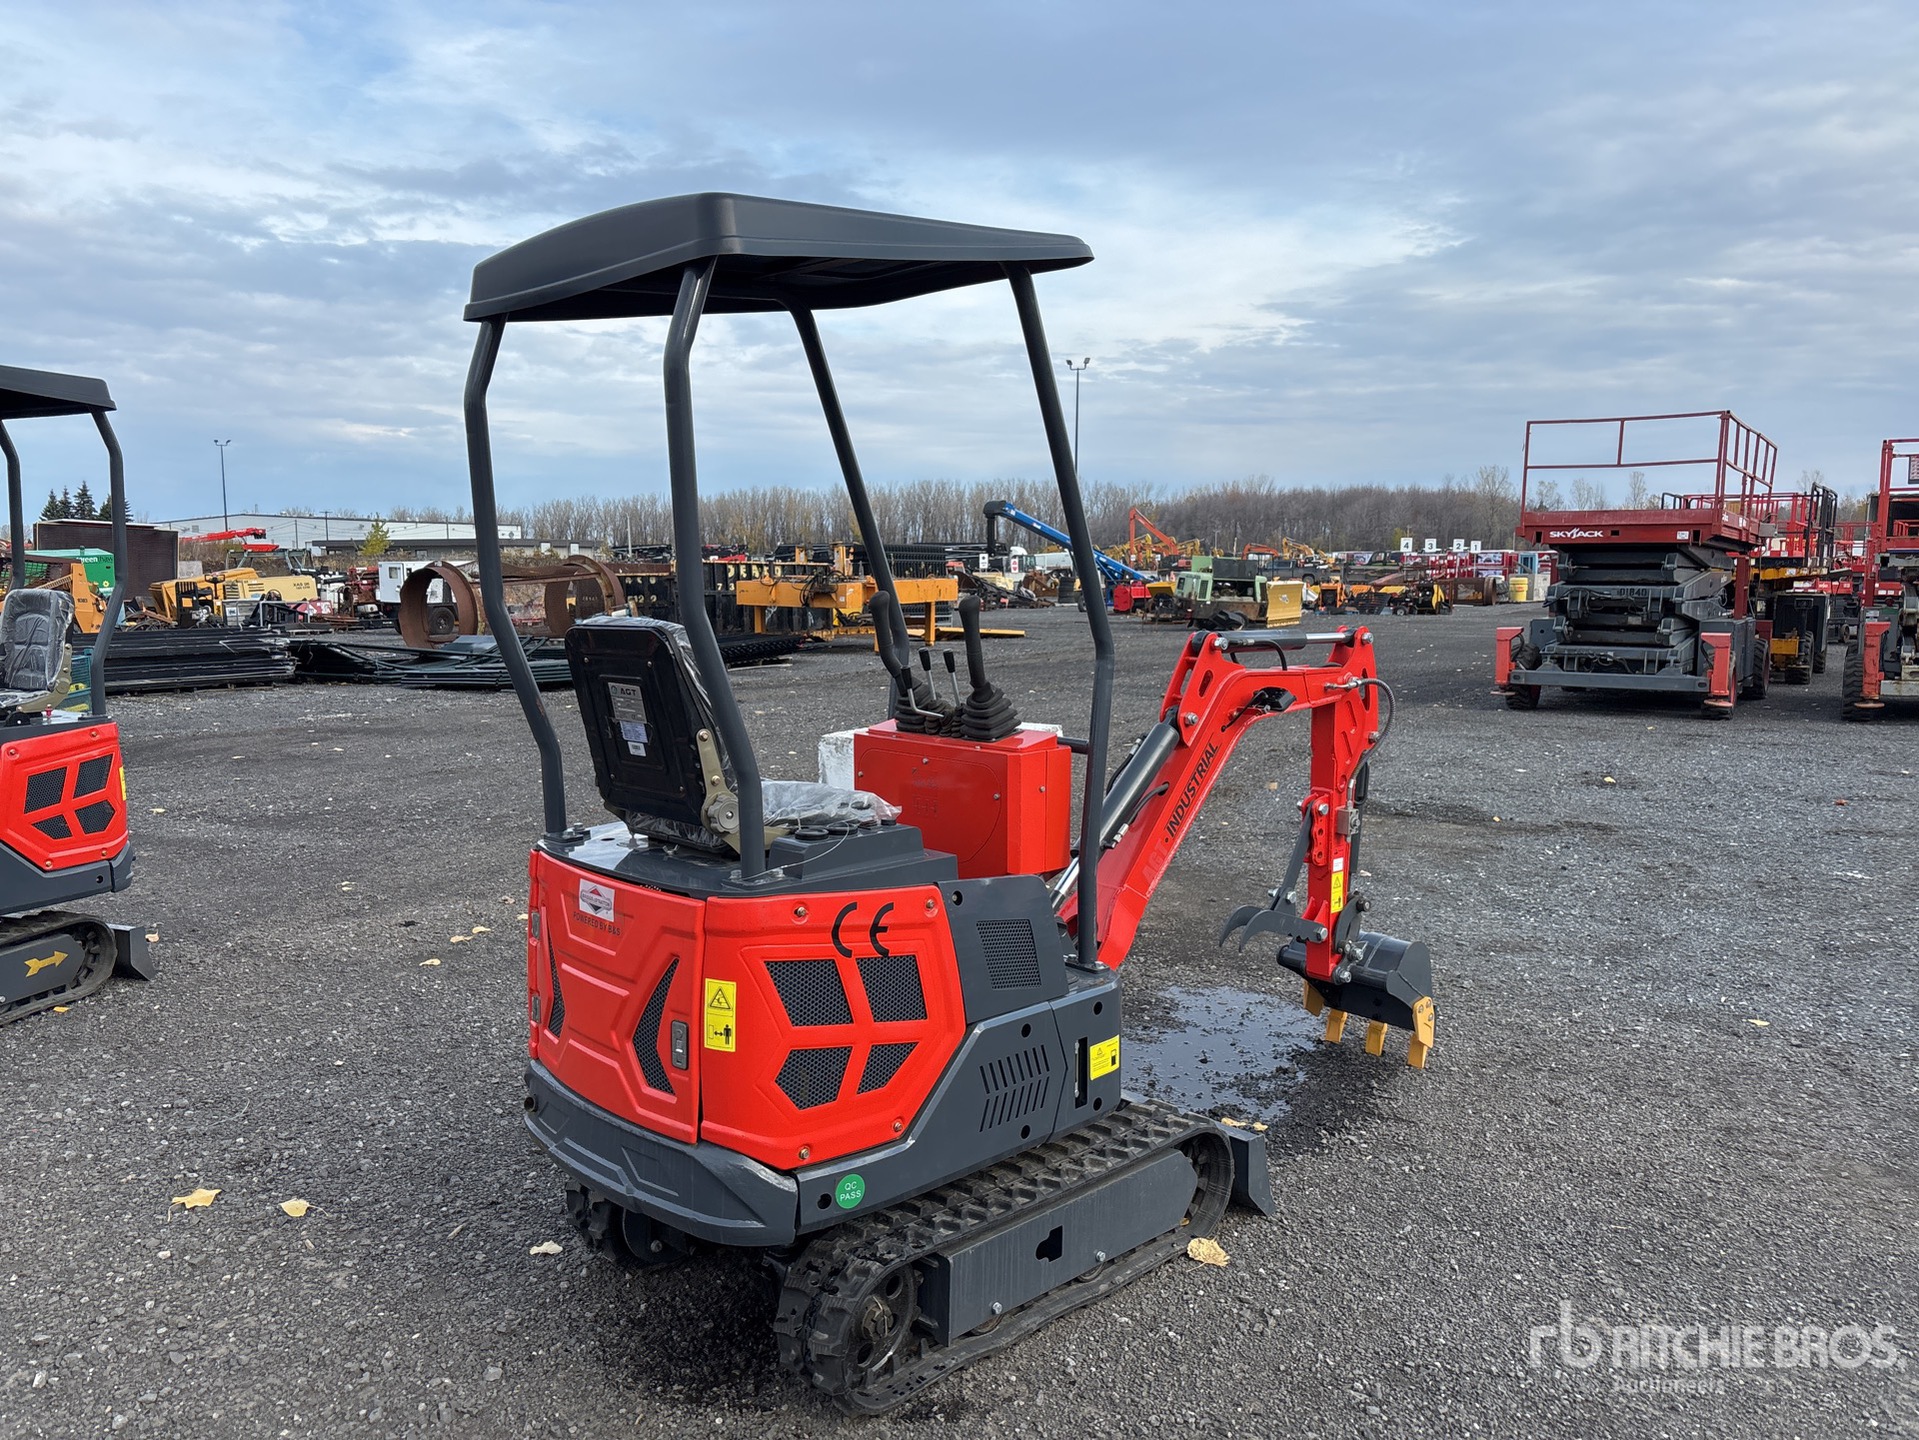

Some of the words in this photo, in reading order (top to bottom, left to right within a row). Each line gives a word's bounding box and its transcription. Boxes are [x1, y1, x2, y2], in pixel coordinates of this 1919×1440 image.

[1549, 527, 1604, 539] SKYJACK
[620, 687, 637, 696] AGT
[1166, 743, 1219, 838] INDUSTRIAL
[573, 911, 599, 929] POWERED
[600, 923, 607, 932] BY
[831, 901, 894, 959] CE
[844, 1181, 857, 1191] QC
[840, 1190, 862, 1202] PASS
